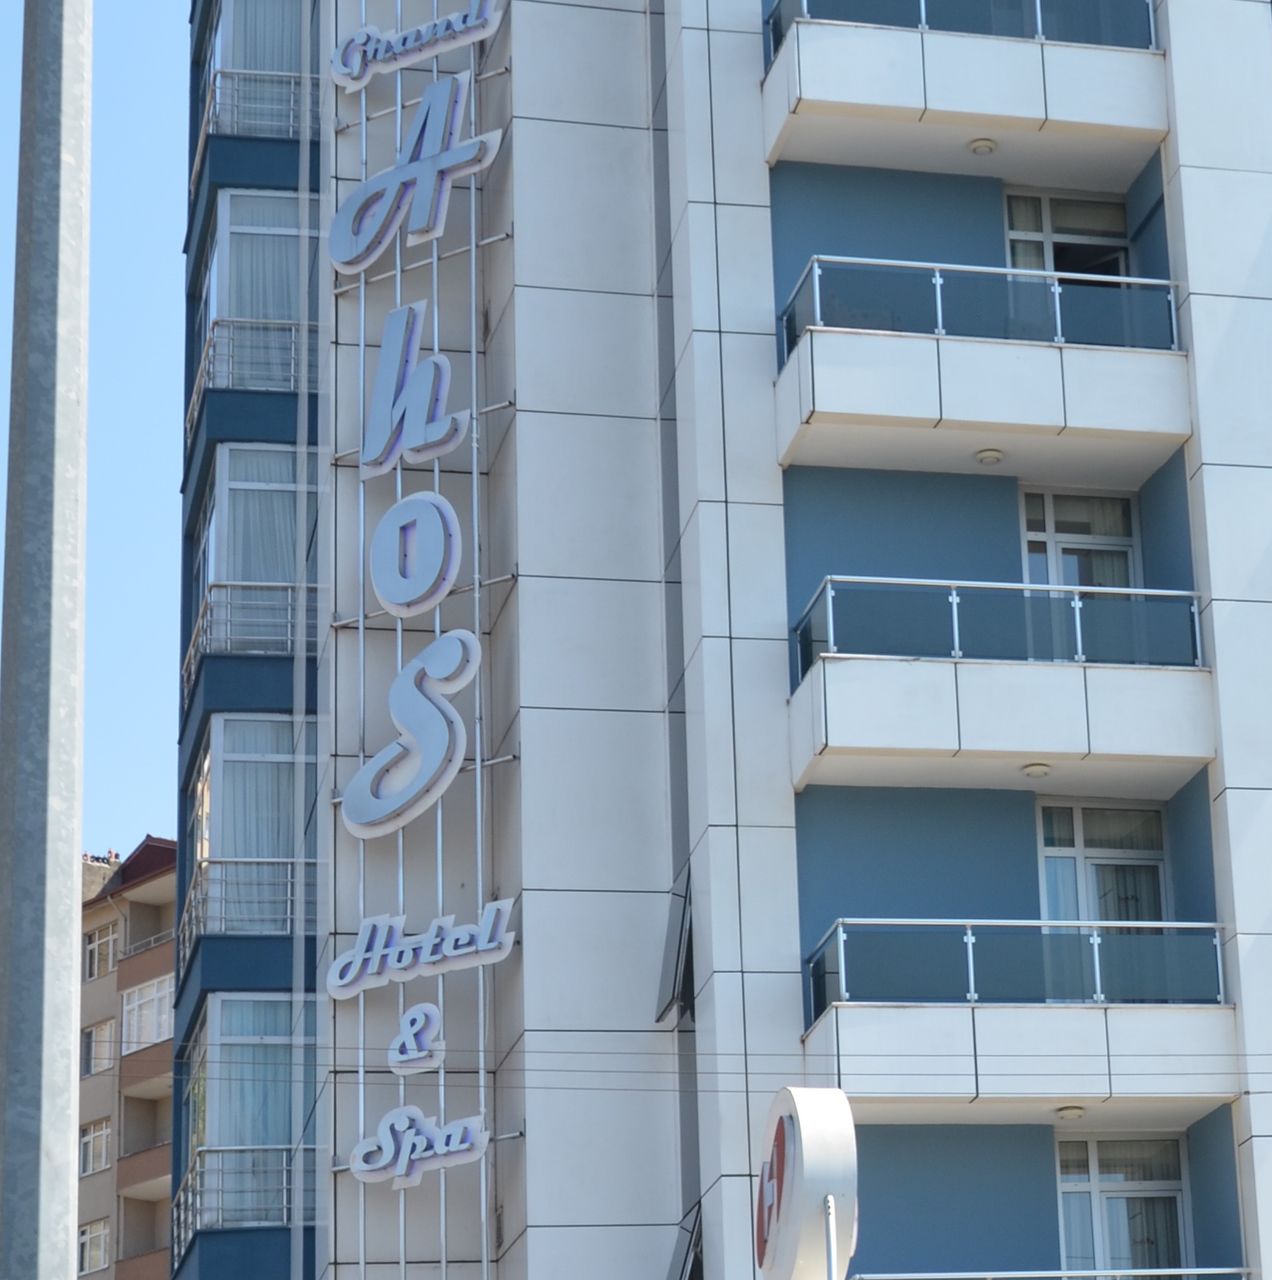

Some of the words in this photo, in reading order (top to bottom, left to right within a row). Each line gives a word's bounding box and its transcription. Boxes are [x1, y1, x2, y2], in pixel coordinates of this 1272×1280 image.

[327, 899, 514, 998] Hotel
[390, 1004, 443, 1073] &
[352, 1107, 488, 1187] Spa
